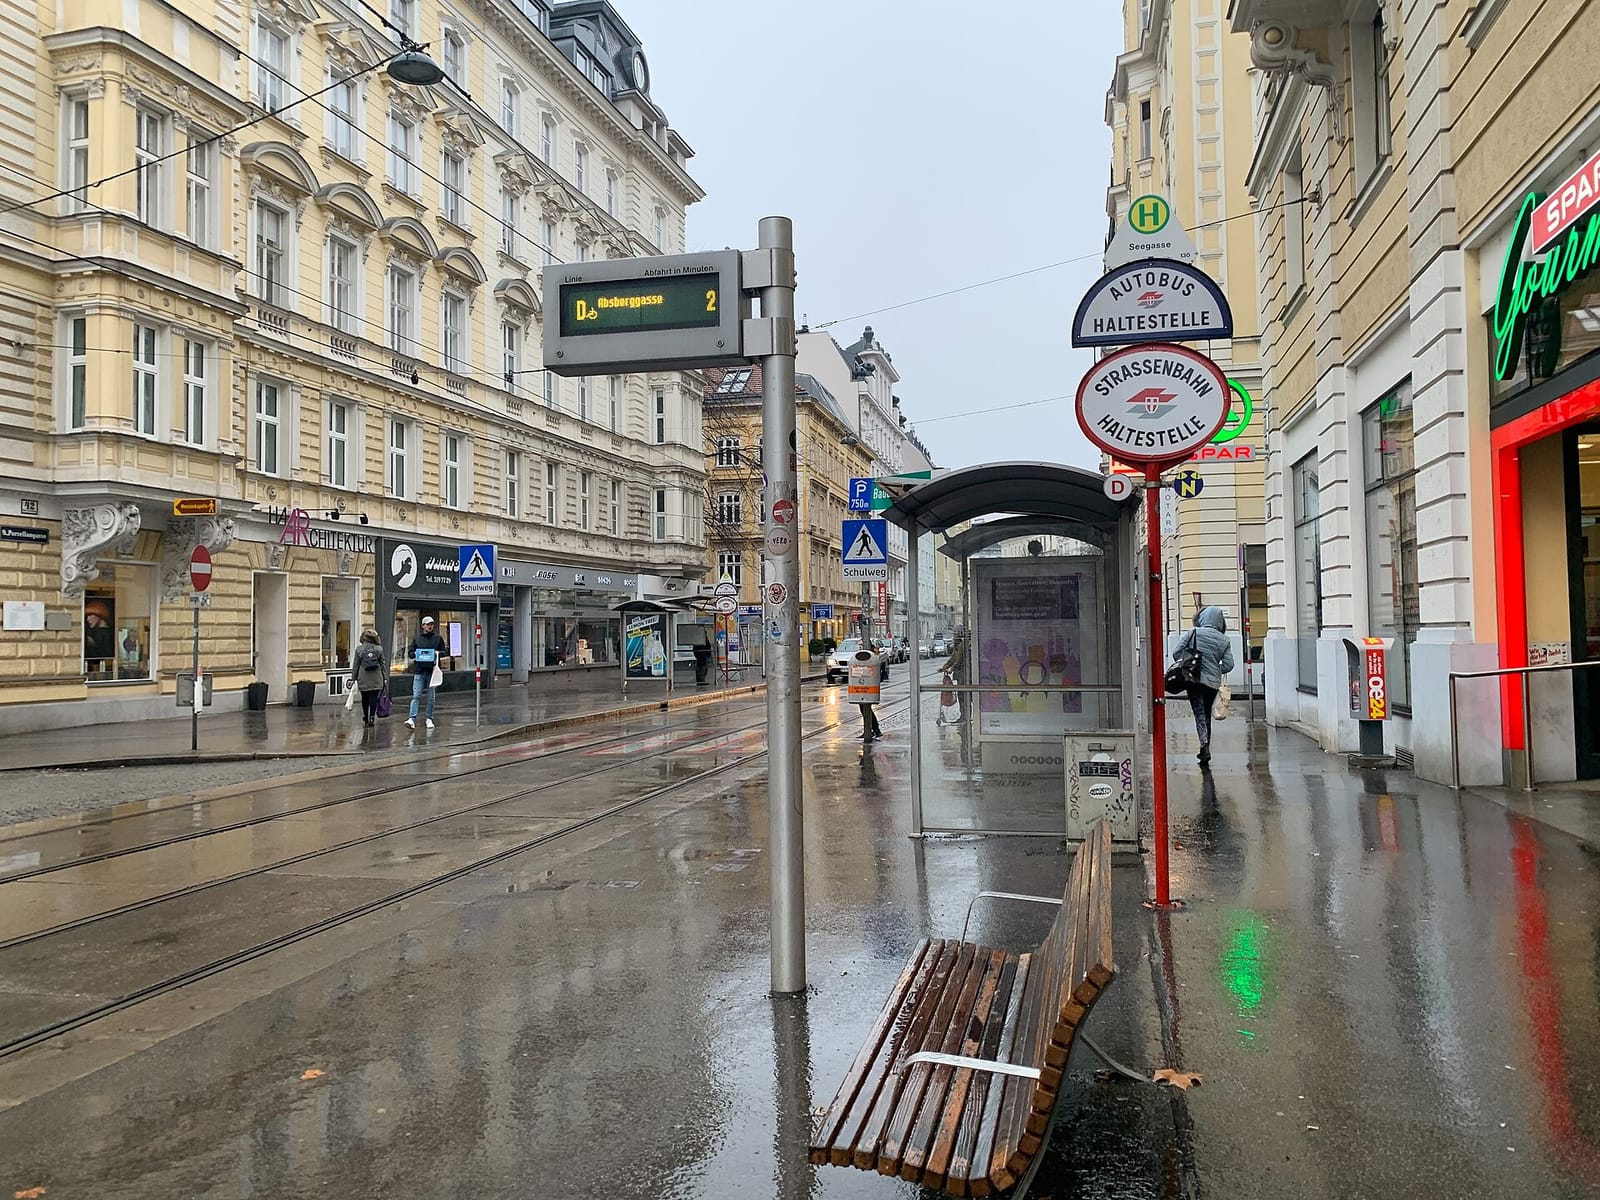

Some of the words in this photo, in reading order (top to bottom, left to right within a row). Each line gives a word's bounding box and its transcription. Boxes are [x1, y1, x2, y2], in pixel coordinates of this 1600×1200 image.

[1138, 202, 1159, 227] H
[1128, 242, 1172, 251] Seegasse
[564, 275, 583, 283] Linie
[644, 268, 672, 277] Abfahrt
[673, 267, 681, 275] in
[682, 264, 714, 274] Minuten
[1109, 271, 1196, 302] AUTOBUS
[576, 299, 587, 321] D
[597, 294, 664, 309] Absberggasse
[705, 289, 717, 312] 2
[1093, 310, 1210, 333] HALTESTELLE
[1094, 358, 1214, 399] STRASSENBAHN
[1096, 413, 1207, 448] HALTESTELLE
[1111, 480, 1125, 495] D
[1181, 479, 1196, 497] N
[843, 567, 887, 578] Schulweg
[460, 584, 493, 593] Schulweg
